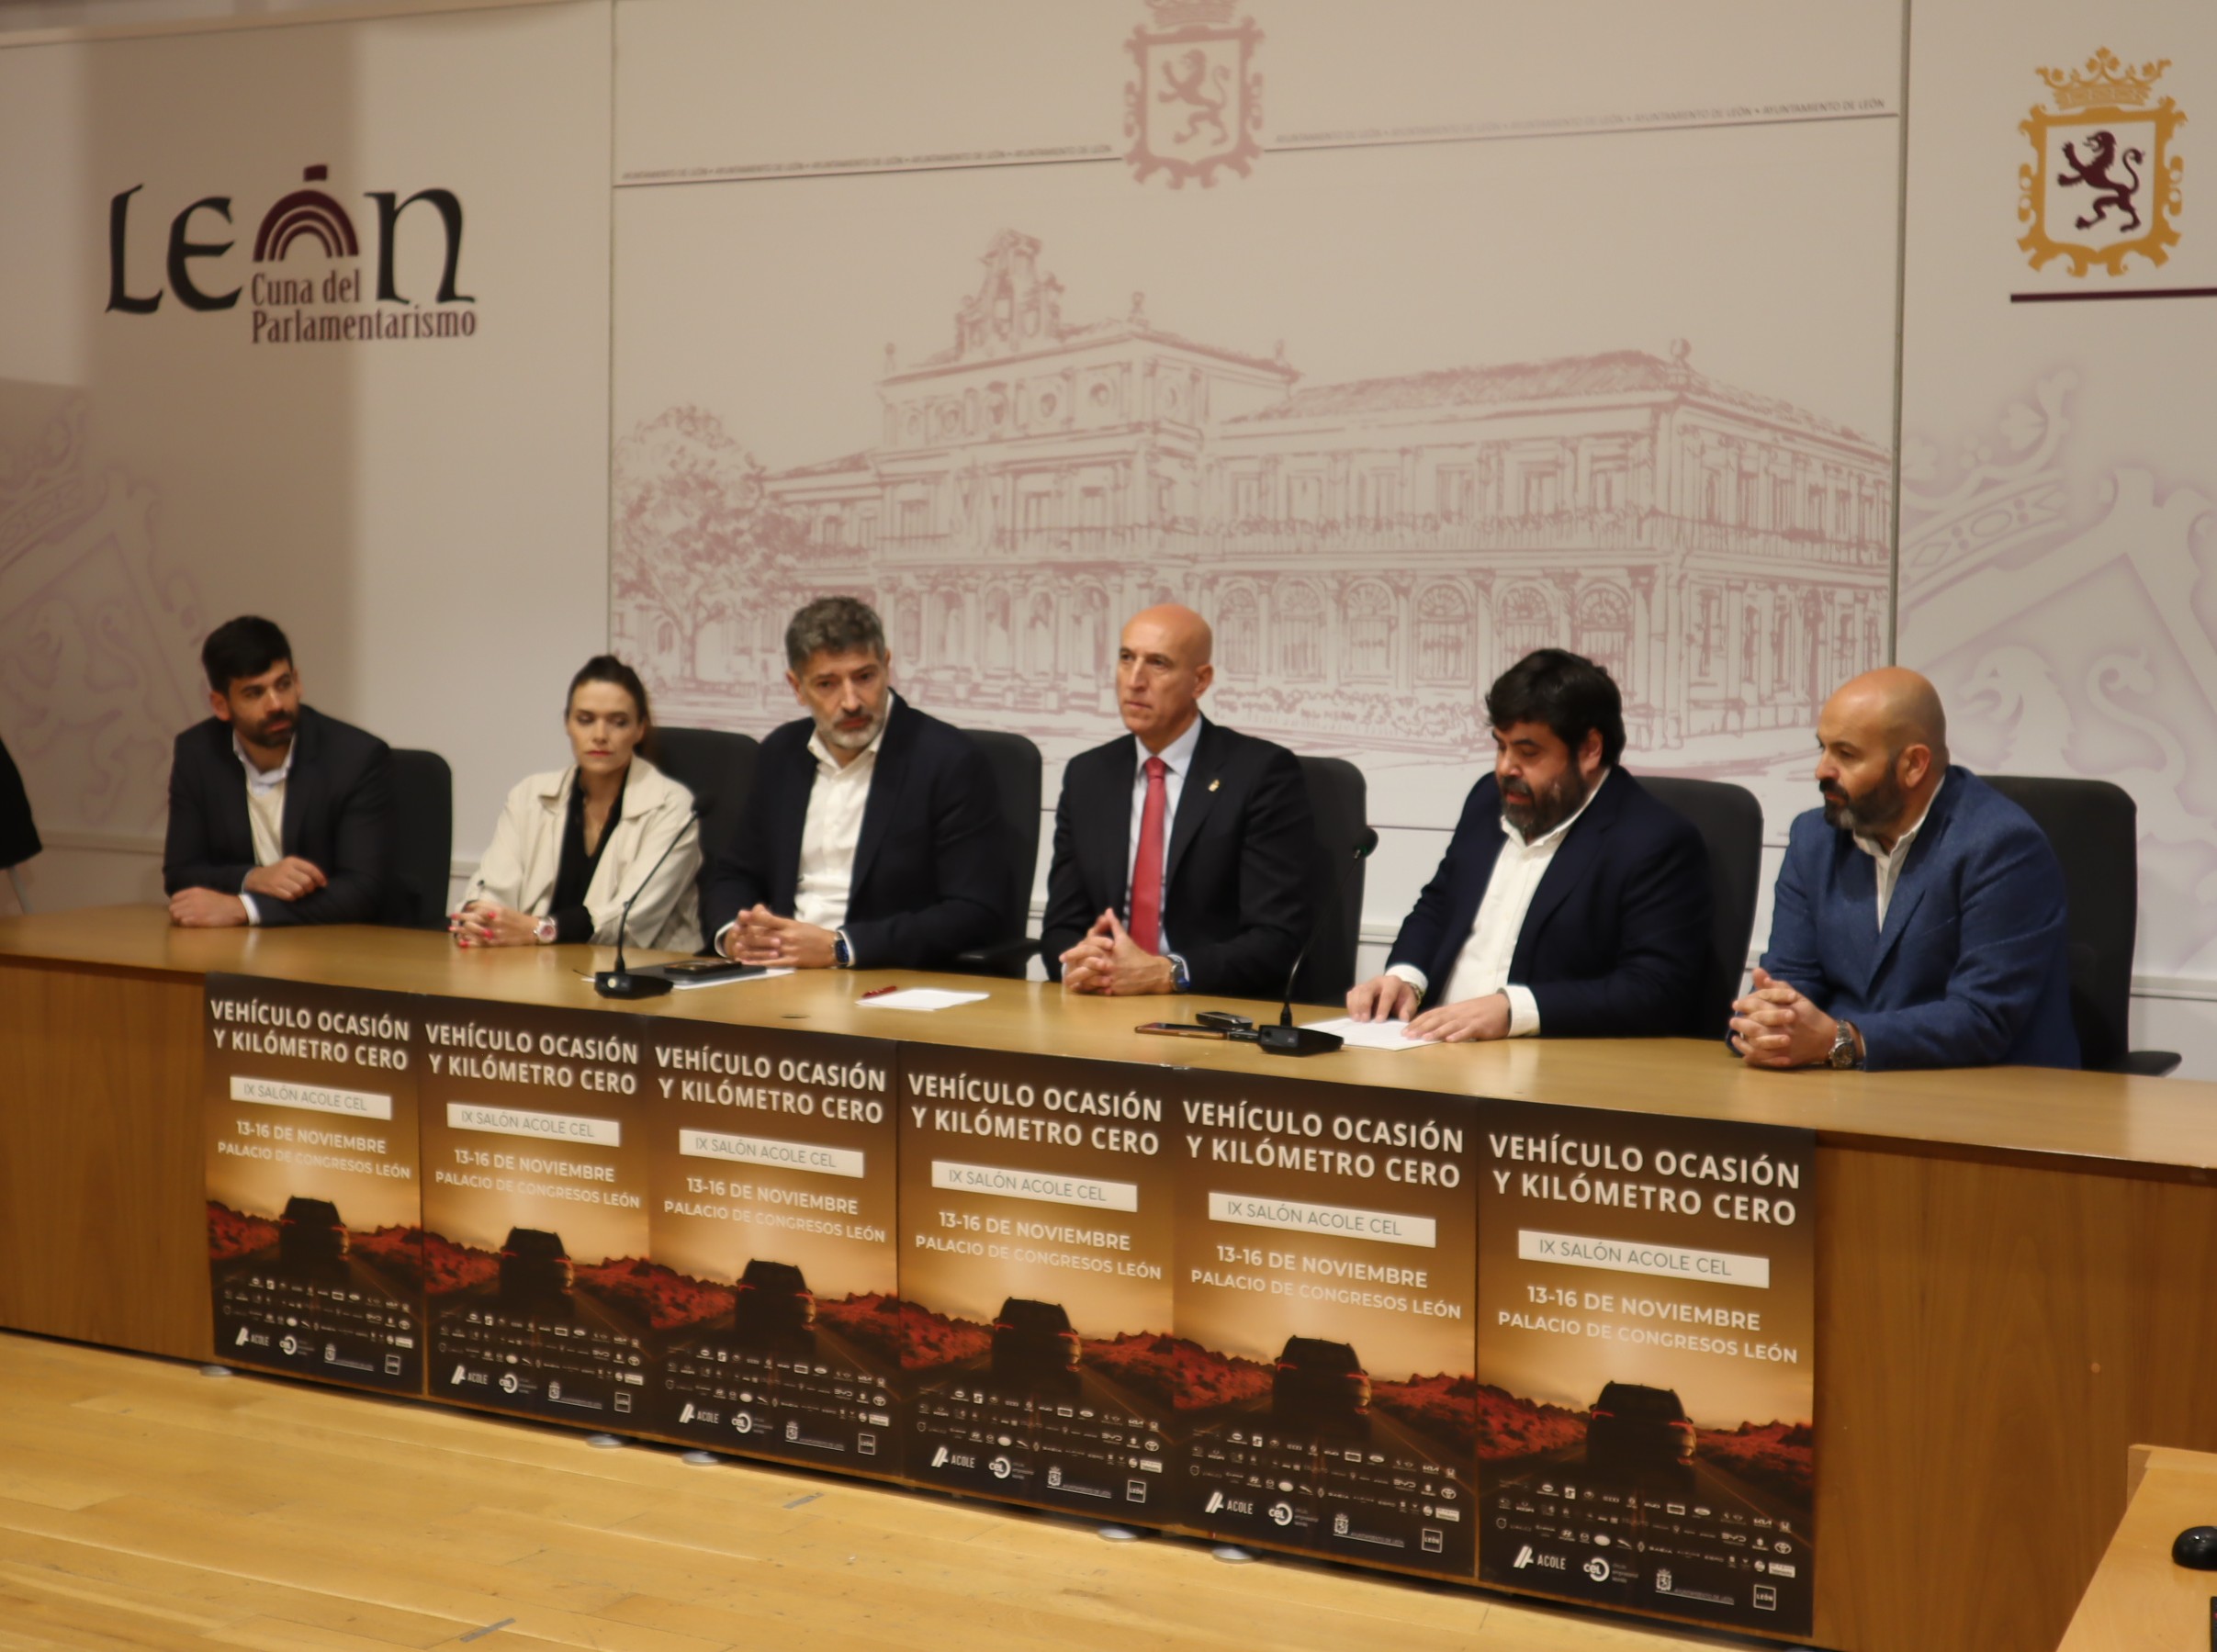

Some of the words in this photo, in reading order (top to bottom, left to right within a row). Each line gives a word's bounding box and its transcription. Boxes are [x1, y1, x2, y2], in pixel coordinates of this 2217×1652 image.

[1763, 100, 1840, 115] AYUNTAMIENTO
[1858, 96, 1885, 110] LEÓN
[251, 272, 314, 307] Cuna
[322, 269, 361, 303] del
[252, 306, 477, 344] Parlamentarismo
[210, 999, 310, 1029] VEHÍCULO
[318, 1011, 409, 1040] OCASIÓN
[214, 1029, 225, 1048] Y
[232, 1030, 348, 1062] KILÓMETRO
[355, 1045, 407, 1070] CERO
[425, 1023, 532, 1052] VEHÍCULO
[540, 1035, 637, 1064] OCASIÓN
[429, 1054, 442, 1073] Y
[449, 1055, 572, 1087] KILÓMETRO
[580, 1070, 636, 1095] CERO
[656, 1046, 771, 1078] VEHÍCULO
[779, 1060, 885, 1092] OCASIÓN
[244, 1084, 254, 1096] IX
[258, 1085, 298, 1102] SALÓN
[300, 1092, 340, 1107] ACOLE
[344, 1096, 366, 1111] CEL
[658, 1079, 673, 1098] Y
[682, 1080, 813, 1115] KILÓMETRO
[822, 1097, 883, 1123] CERO
[908, 1073, 1034, 1107] VEHÍCULO
[1044, 1089, 1161, 1121] OCASIÓN
[237, 1121, 269, 1137] 13-16
[275, 1126, 293, 1141] DE
[298, 1129, 386, 1153] NOVIEMBRE
[462, 1111, 472, 1122] IX
[477, 1111, 518, 1128] SALÓN
[523, 1119, 565, 1134] ACOLE
[569, 1123, 594, 1138] CEL
[912, 1107, 926, 1128] Y
[936, 1108, 1081, 1146] KILÓMETRO
[1092, 1127, 1159, 1155] CERO
[1183, 1101, 1322, 1137] VEHÍCULO
[1334, 1118, 1463, 1153] OCASIÓN
[219, 1142, 272, 1160] PALACIO
[276, 1151, 290, 1163] DE
[295, 1152, 371, 1174] CONGRESOS
[376, 1162, 410, 1179] LEÓN
[455, 1149, 489, 1166] 13-16
[494, 1154, 514, 1170] DE
[520, 1158, 614, 1183] NOVIEMBRE
[696, 1137, 707, 1151] IX
[712, 1140, 756, 1157] SALÓN
[760, 1148, 805, 1163] ACOLE
[810, 1152, 836, 1167] CEL
[1187, 1136, 1203, 1158] Y
[1212, 1139, 1375, 1178] KILÓMETRO
[1386, 1159, 1459, 1188] CERO
[1490, 1134, 1643, 1172] VEHÍCULO
[1656, 1152, 1799, 1189] OCASIÓN
[436, 1171, 491, 1189] PALACIO
[497, 1181, 513, 1192] DE
[518, 1182, 599, 1203] CONGRESOS
[603, 1192, 639, 1208] LEÓN
[687, 1178, 724, 1196] 13-16
[730, 1183, 752, 1199] DE
[758, 1187, 858, 1215] NOVIEMBRE
[950, 1170, 962, 1183] IX
[967, 1172, 1017, 1189] SALÓN
[1021, 1181, 1072, 1197] ACOLE
[1077, 1186, 1106, 1201] CEL
[1493, 1171, 1510, 1194] Y
[1523, 1174, 1701, 1215] KILÓMETRO
[1714, 1195, 1795, 1225] CERO
[665, 1201, 727, 1219] PALACIO
[733, 1210, 750, 1223] DE
[757, 1212, 842, 1236] CONGRESOS
[847, 1225, 884, 1242] LEÓN
[940, 1211, 980, 1231] 13-16
[986, 1218, 1010, 1235] DE
[1017, 1222, 1131, 1251] NOVIEMBRE
[1228, 1201, 1242, 1216] IX
[1247, 1204, 1302, 1222] SALÓN
[1308, 1213, 1364, 1231] ACOLE
[1370, 1219, 1401, 1236] CEL
[916, 1235, 984, 1255] PALACIO
[988, 1245, 1008, 1259] DE
[1014, 1248, 1112, 1273] CONGRESOS
[1118, 1262, 1161, 1279] LEÓN
[1217, 1245, 1262, 1265] 13-16
[1269, 1253, 1295, 1271] DE
[1302, 1256, 1427, 1288] NOVIEMBRE
[1540, 1240, 1555, 1255] IX
[1561, 1242, 1621, 1262] SALÓN
[1627, 1253, 1690, 1271] ACOLE
[1696, 1258, 1731, 1276] CEL
[1192, 1270, 1266, 1291] PALACIO
[1271, 1280, 1293, 1297] DE
[1300, 1285, 1407, 1311] CONGRESOS
[1413, 1299, 1460, 1319] LEÓN
[1527, 1287, 1577, 1307] 13-16
[1585, 1293, 1614, 1313] DE
[1622, 1298, 1760, 1331] NOVIEMBRE
[1499, 1312, 1580, 1334] PALACIO
[1587, 1323, 1611, 1340] DE
[1618, 1328, 1738, 1355] CONGRESOS
[1745, 1343, 1797, 1364] LEÓN
[467, 1372, 488, 1385] ACOLE
[697, 1410, 719, 1423] ACOLE
[951, 1455, 975, 1468] ACOLE
[1393, 1479, 1416, 1488] BYD
[1227, 1500, 1253, 1514] ACOLE
[1721, 1533, 1746, 1542] BYD
[1537, 1555, 1566, 1570] ACOLE
